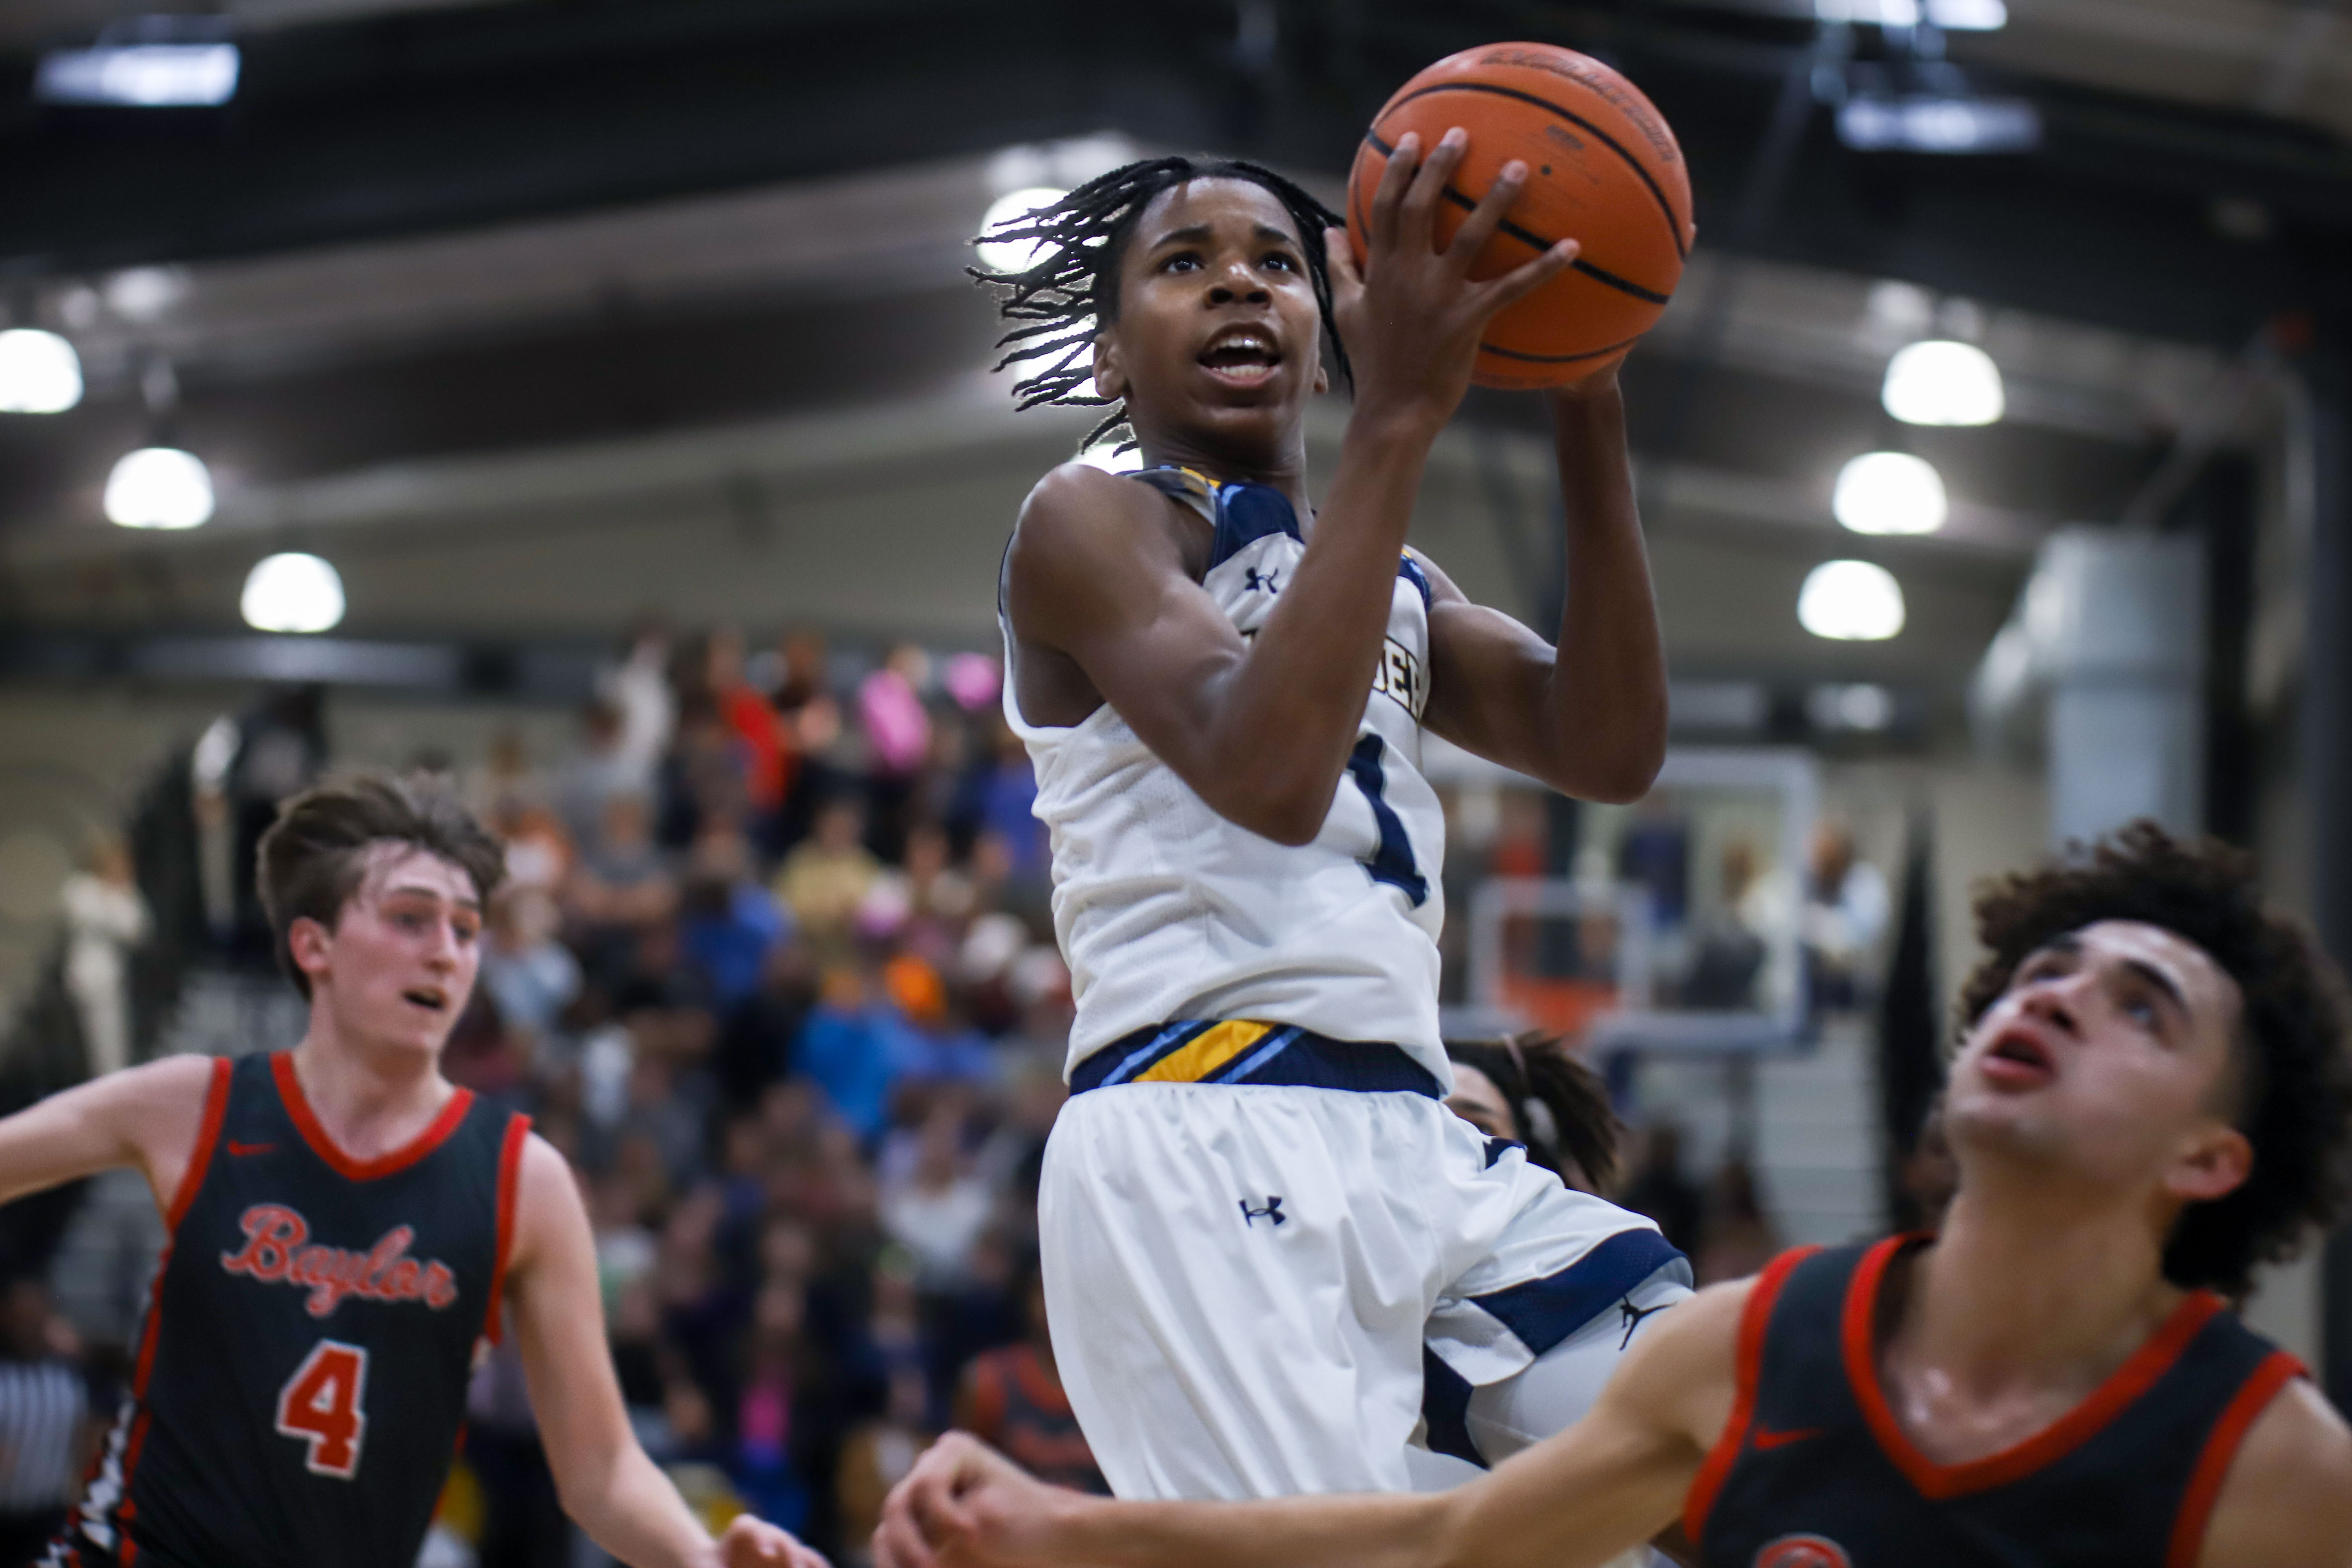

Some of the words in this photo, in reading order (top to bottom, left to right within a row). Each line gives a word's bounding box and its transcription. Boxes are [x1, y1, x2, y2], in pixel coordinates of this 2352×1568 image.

[1347, 733, 1429, 909] 1
[221, 1202, 458, 1317] Baylor
[275, 1338, 368, 1480] 4
